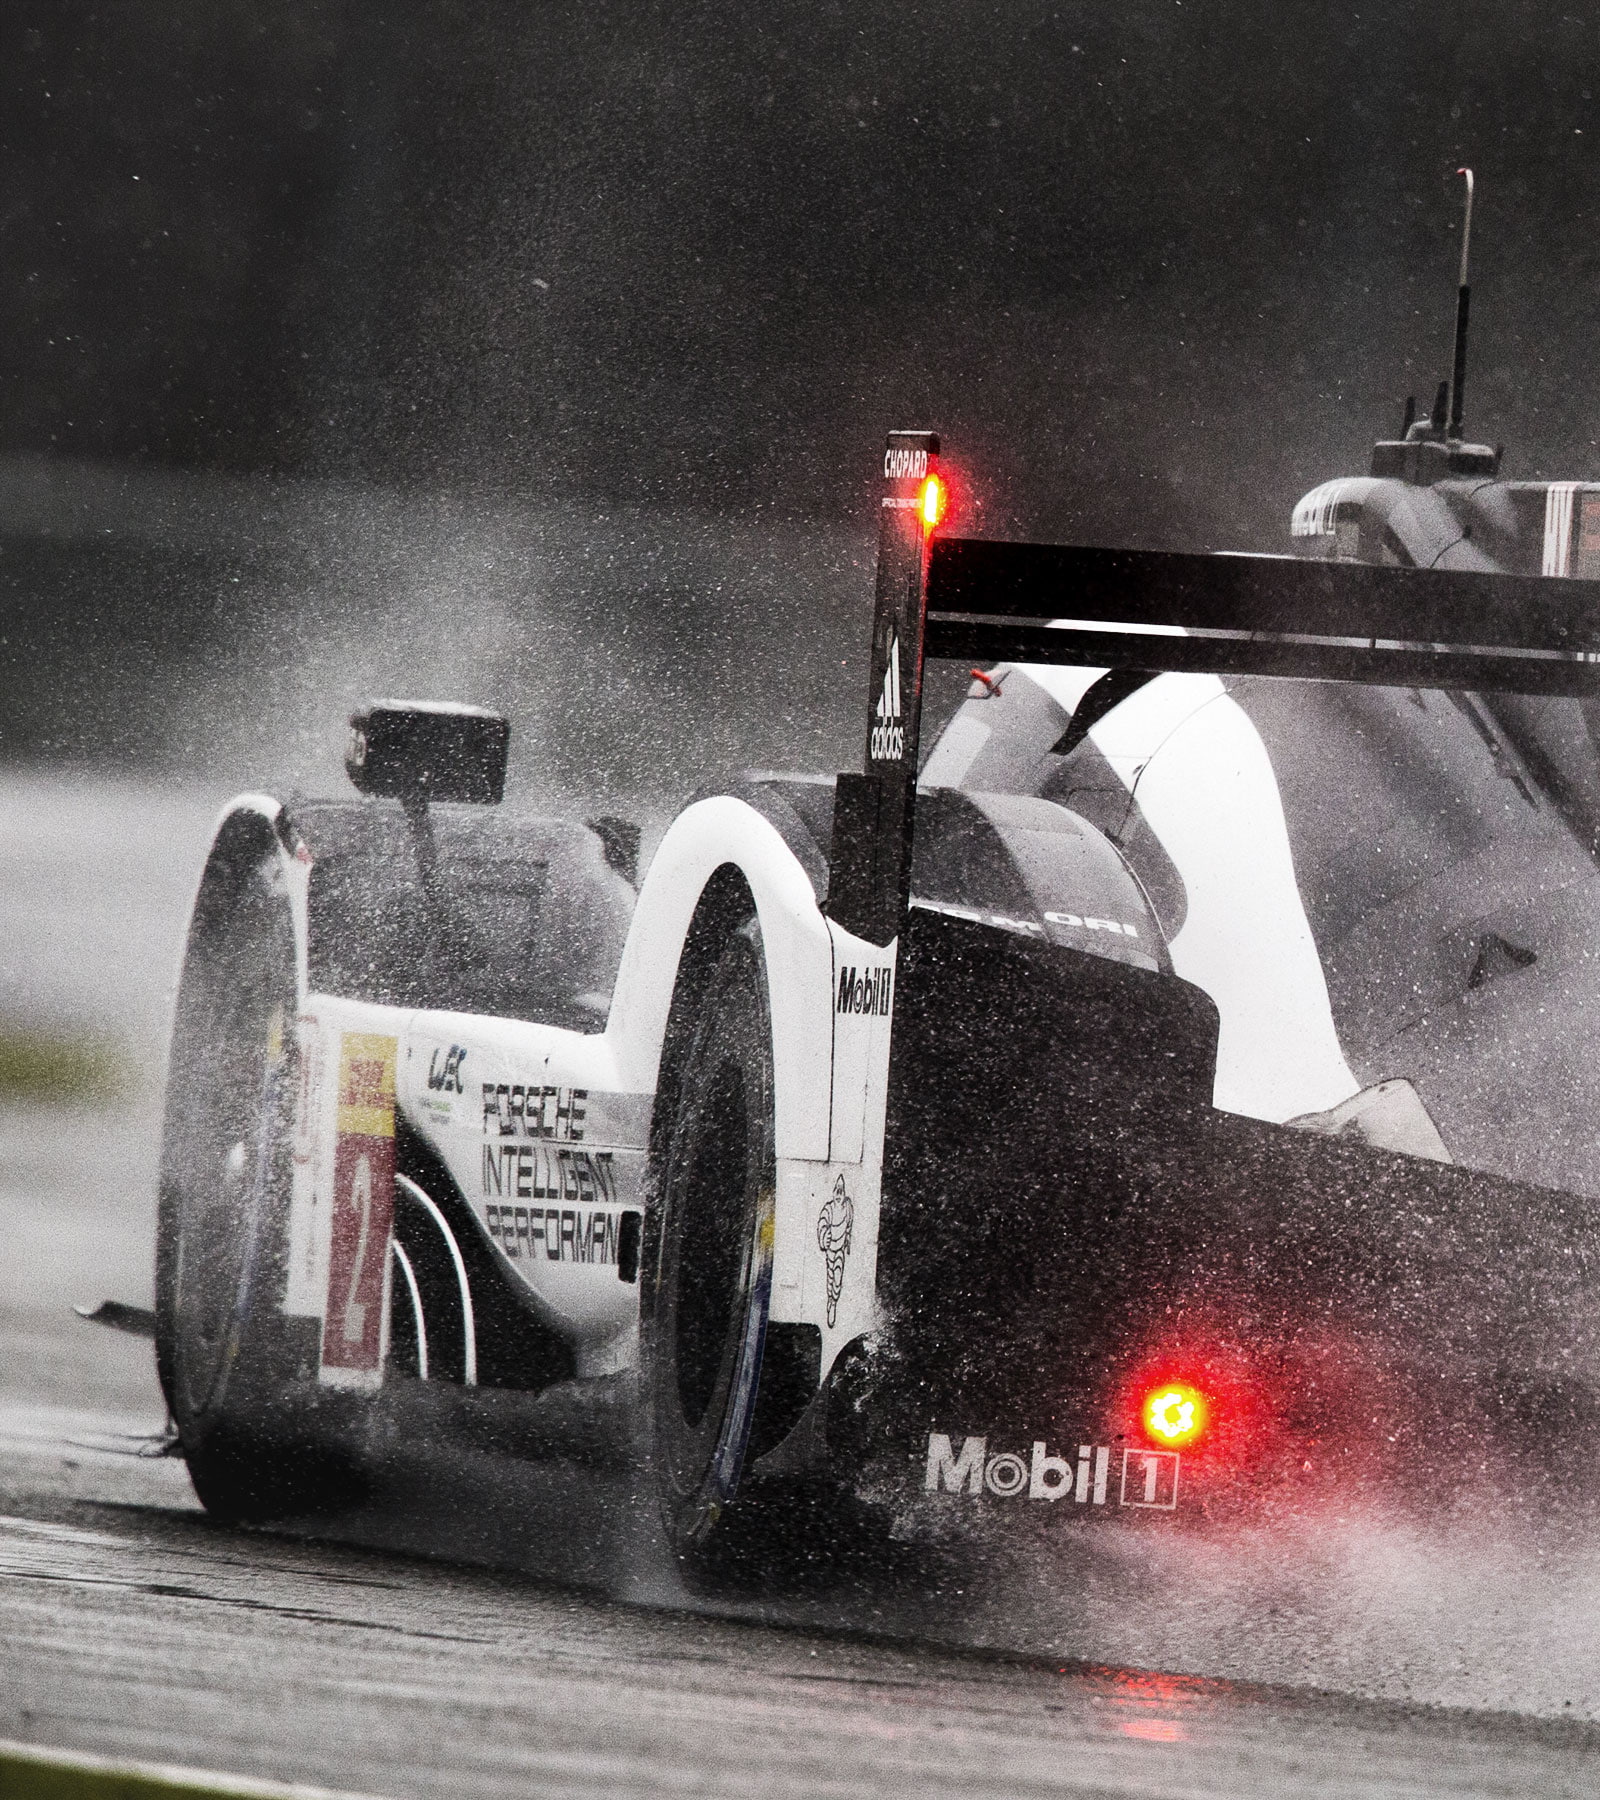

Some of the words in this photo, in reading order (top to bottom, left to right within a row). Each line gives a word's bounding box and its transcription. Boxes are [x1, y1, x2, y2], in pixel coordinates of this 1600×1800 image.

[884, 449, 928, 478] CHOPARD
[871, 716, 904, 760] adidas
[837, 966, 880, 1016] Mobil
[483, 1083, 588, 1140] PORSCHE
[483, 1143, 617, 1202] INTELLIGENT
[343, 1152, 373, 1343] 2
[486, 1204, 620, 1265] PERFORMAN
[925, 1433, 1110, 1504] Mobil
